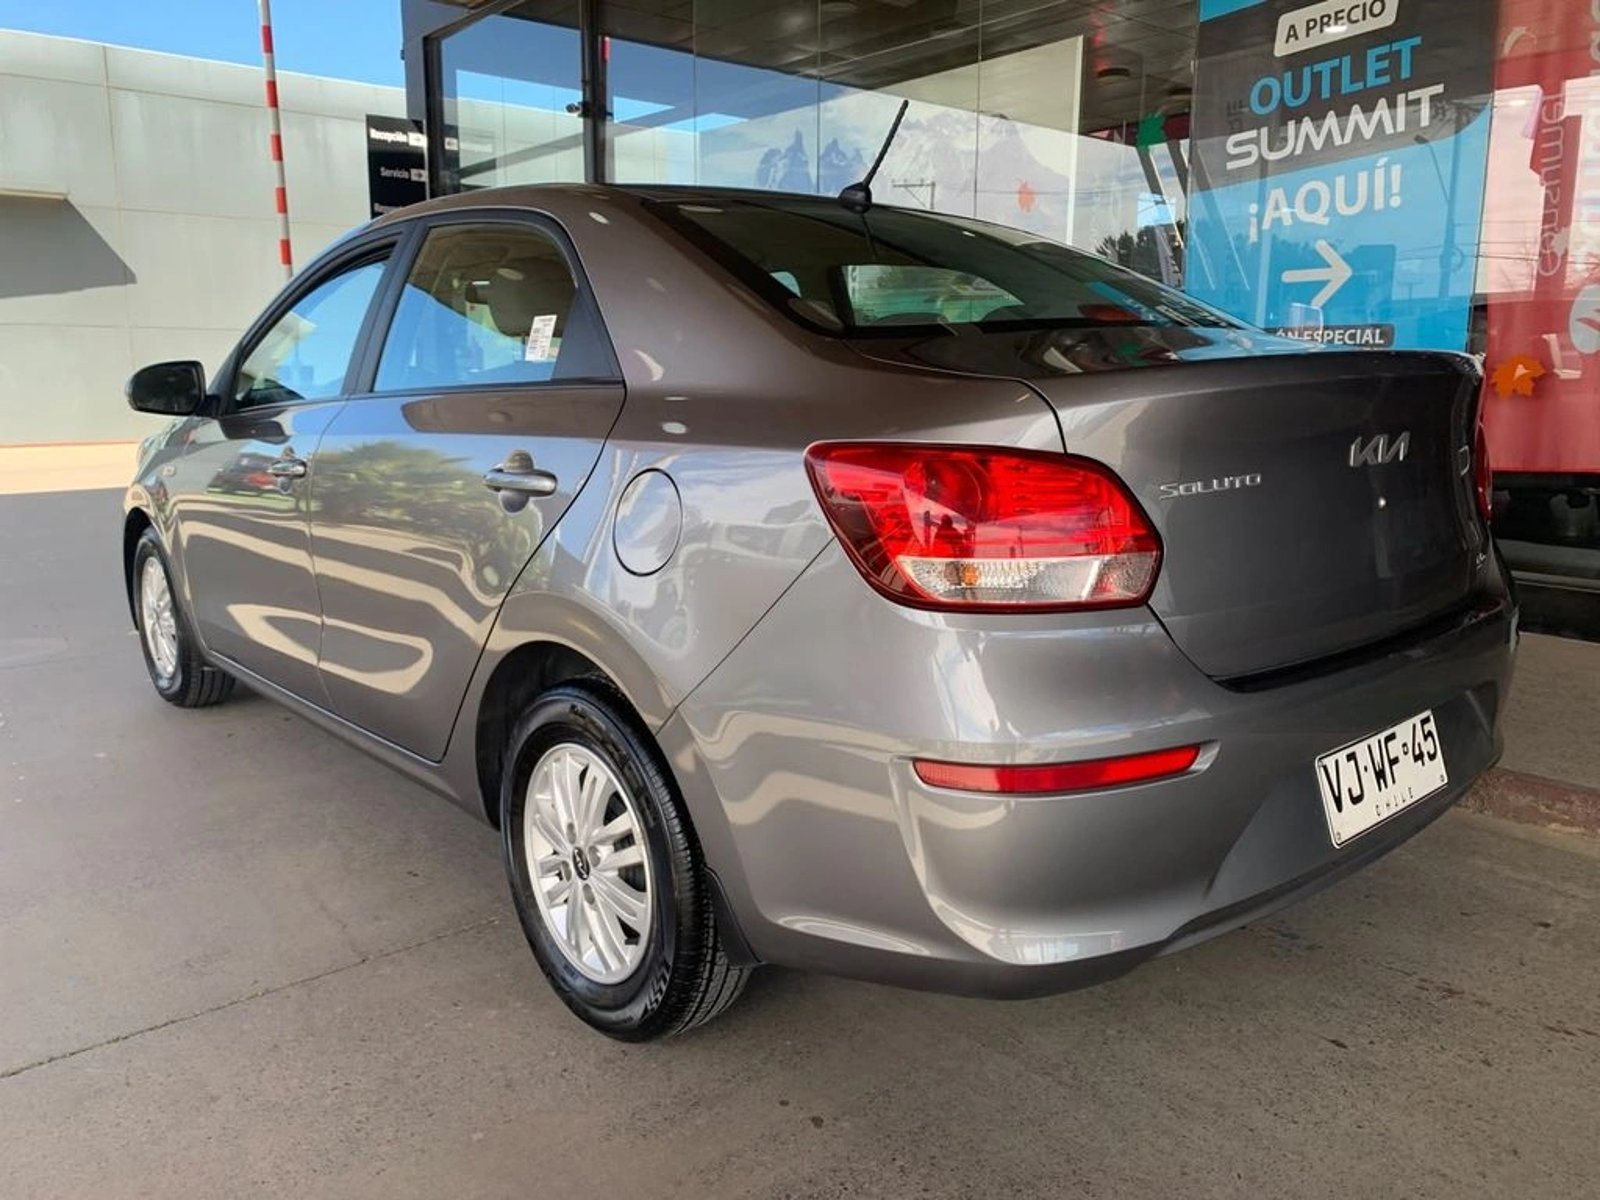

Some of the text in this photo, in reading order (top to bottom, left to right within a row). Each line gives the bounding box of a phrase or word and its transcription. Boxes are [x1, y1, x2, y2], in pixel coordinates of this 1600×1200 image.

[1285, 0, 1386, 44] A PRECIO
[1250, 36, 1422, 115] OUTLET
[1226, 83, 1445, 171] SUMMIT
[1249, 157, 1402, 244] ¡AQUÍ!
[1304, 328, 1385, 345] ESPECIAL
[1350, 431, 1410, 467] KIA
[1159, 473, 1261, 500] SOLUTO
